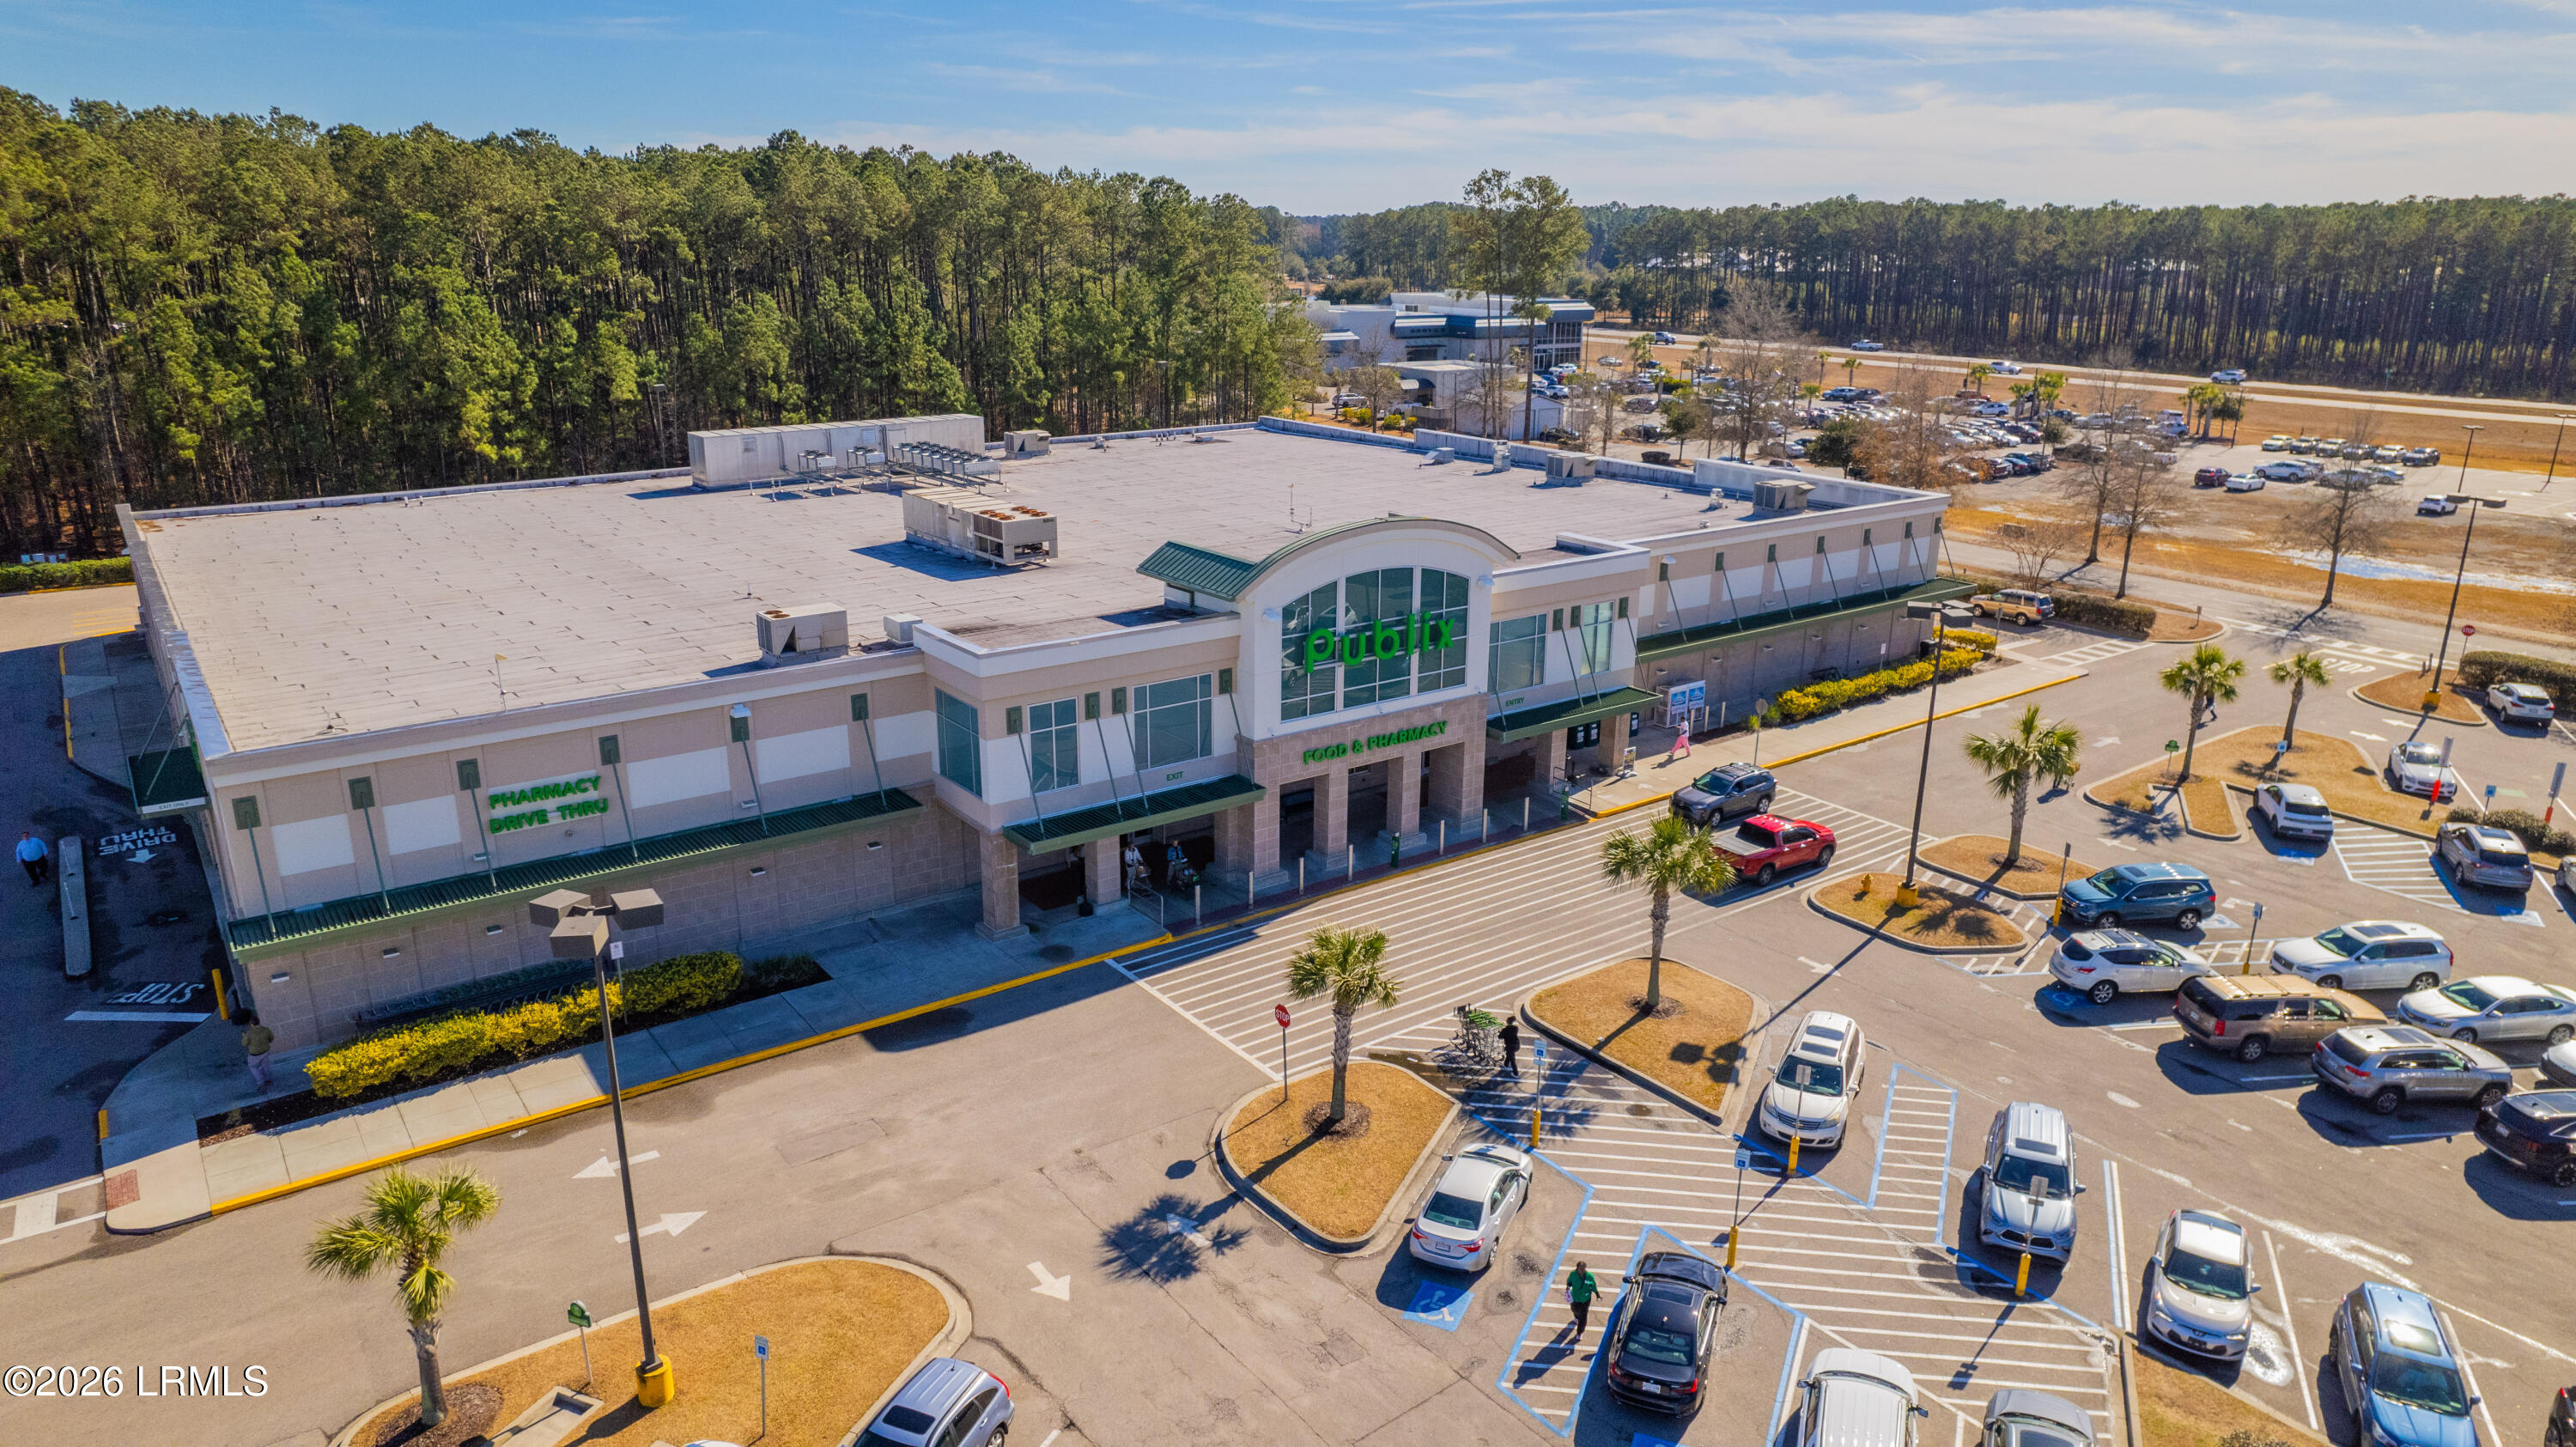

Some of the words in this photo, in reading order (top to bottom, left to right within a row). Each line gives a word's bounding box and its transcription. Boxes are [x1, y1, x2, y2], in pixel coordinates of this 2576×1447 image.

[1304, 611, 1455, 674] Publix
[2321, 657, 2377, 674] STOP
[1505, 696, 1525, 707] ENTRY
[1303, 743, 1349, 765] FOOD
[1352, 739, 1364, 755] &
[1367, 720, 1449, 751] PHARMACY
[1166, 771, 1183, 781] EXIT
[489, 775, 601, 810] PHARMACY
[489, 808, 550, 835] DRIVE
[556, 798, 609, 821] THRU
[99, 833, 177, 856] DRIVE
[100, 825, 172, 846] THRU
[1275, 1008, 1290, 1023] STOP
